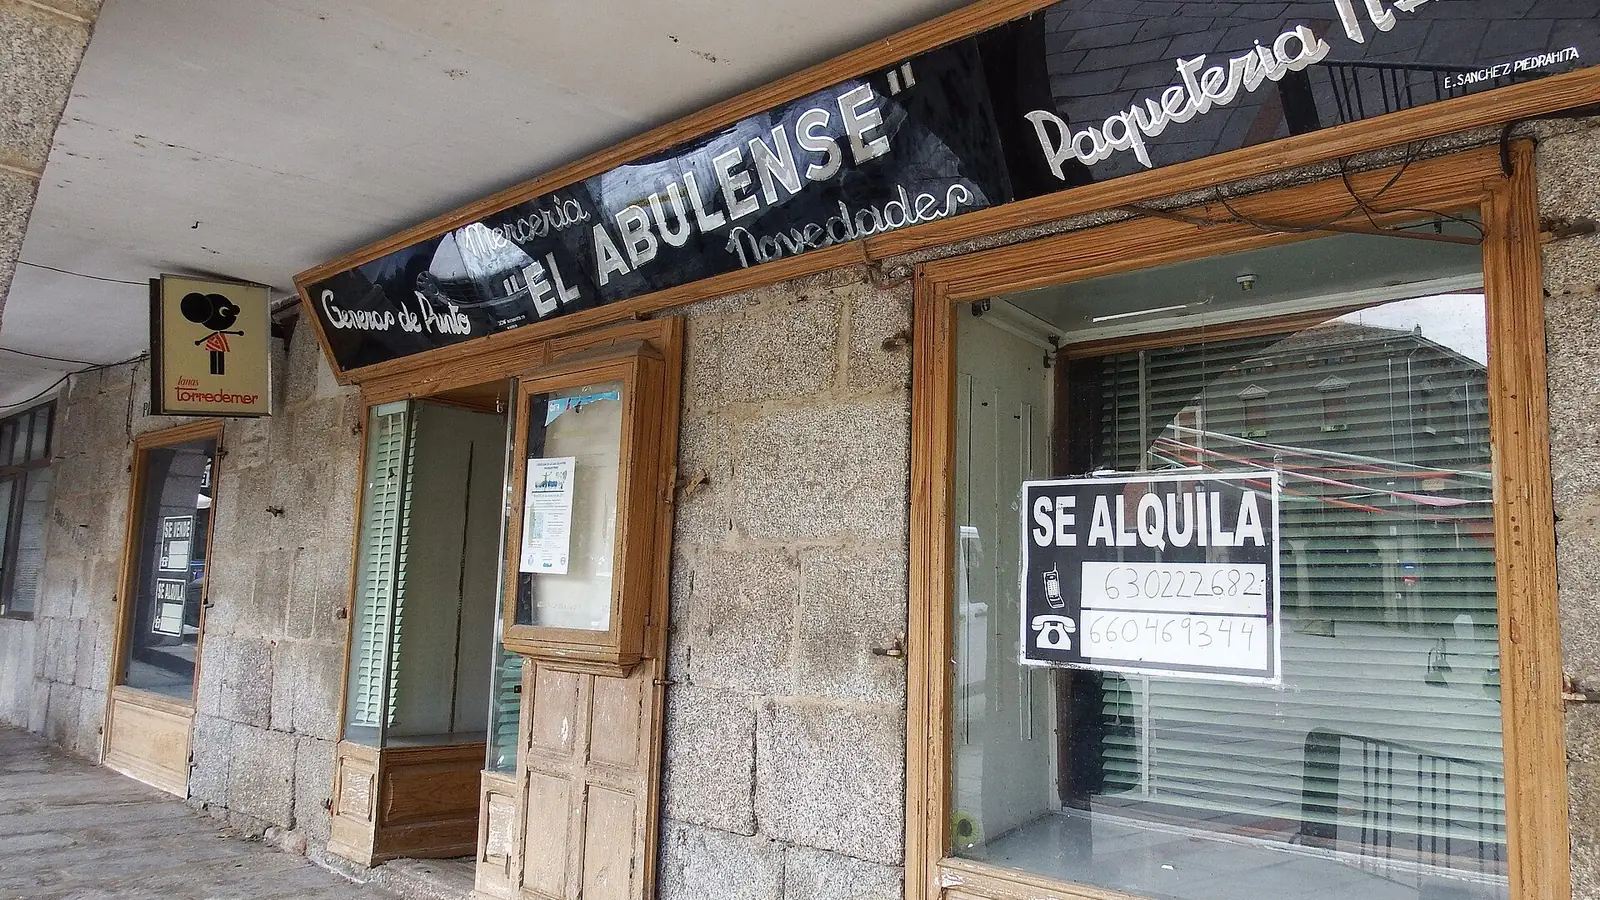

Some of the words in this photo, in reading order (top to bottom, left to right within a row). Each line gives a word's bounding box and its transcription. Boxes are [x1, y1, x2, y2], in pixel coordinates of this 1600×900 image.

[1513, 46, 1580, 73] PIEDRAHITA
[1023, 24, 1331, 181] Paqueteria
[465, 194, 592, 261] Merceria
[724, 183, 973, 268] Novedades
[397, 301, 423, 333] de
[414, 290, 472, 335] Punto
[174, 388, 259, 405] torredemer
[177, 375, 199, 387] lanas
[164, 522, 173, 538] SE
[1032, 495, 1077, 547] SE
[1087, 490, 1266, 552] ALQUILA
[1089, 615, 1255, 652] 660469344
